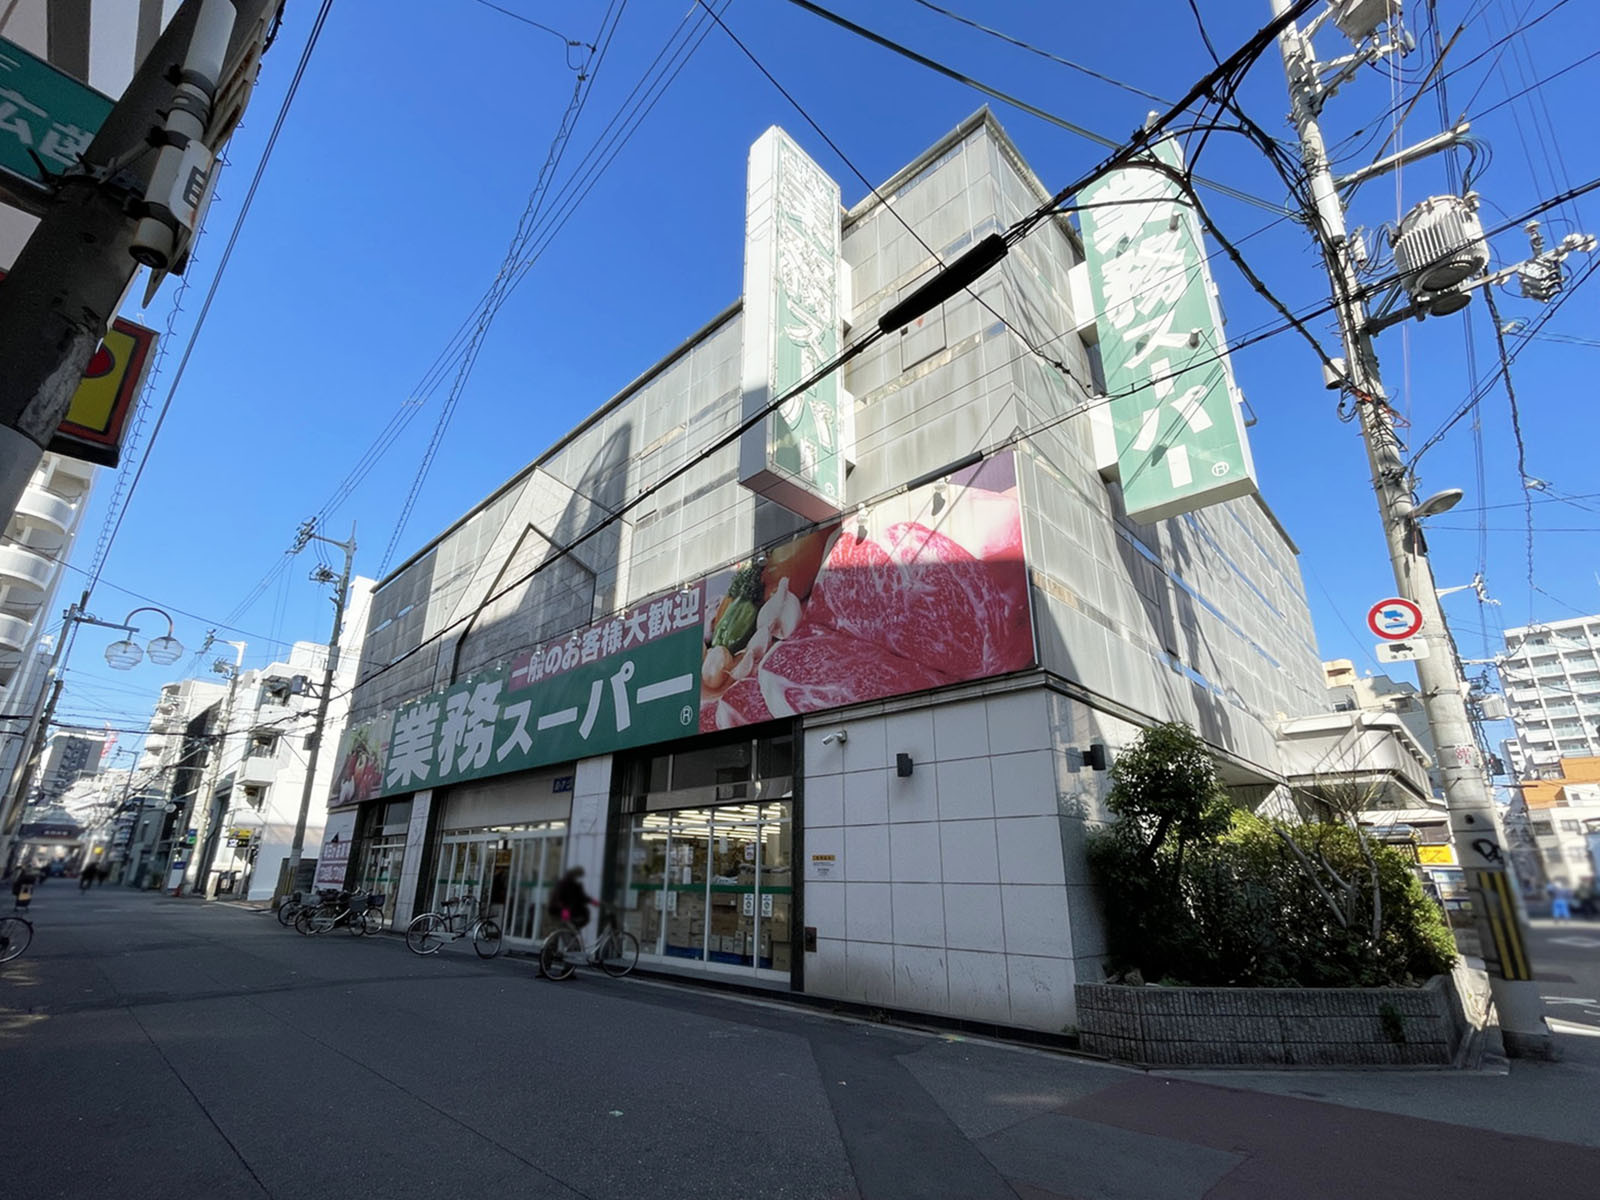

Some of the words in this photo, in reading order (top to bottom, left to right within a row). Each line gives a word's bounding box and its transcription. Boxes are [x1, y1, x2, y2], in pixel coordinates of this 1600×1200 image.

[1088, 157, 1213, 489] 業務スーパー
[512, 587, 700, 683] 一般のお客様大歓迎
[386, 660, 693, 789] 業務スーパー
